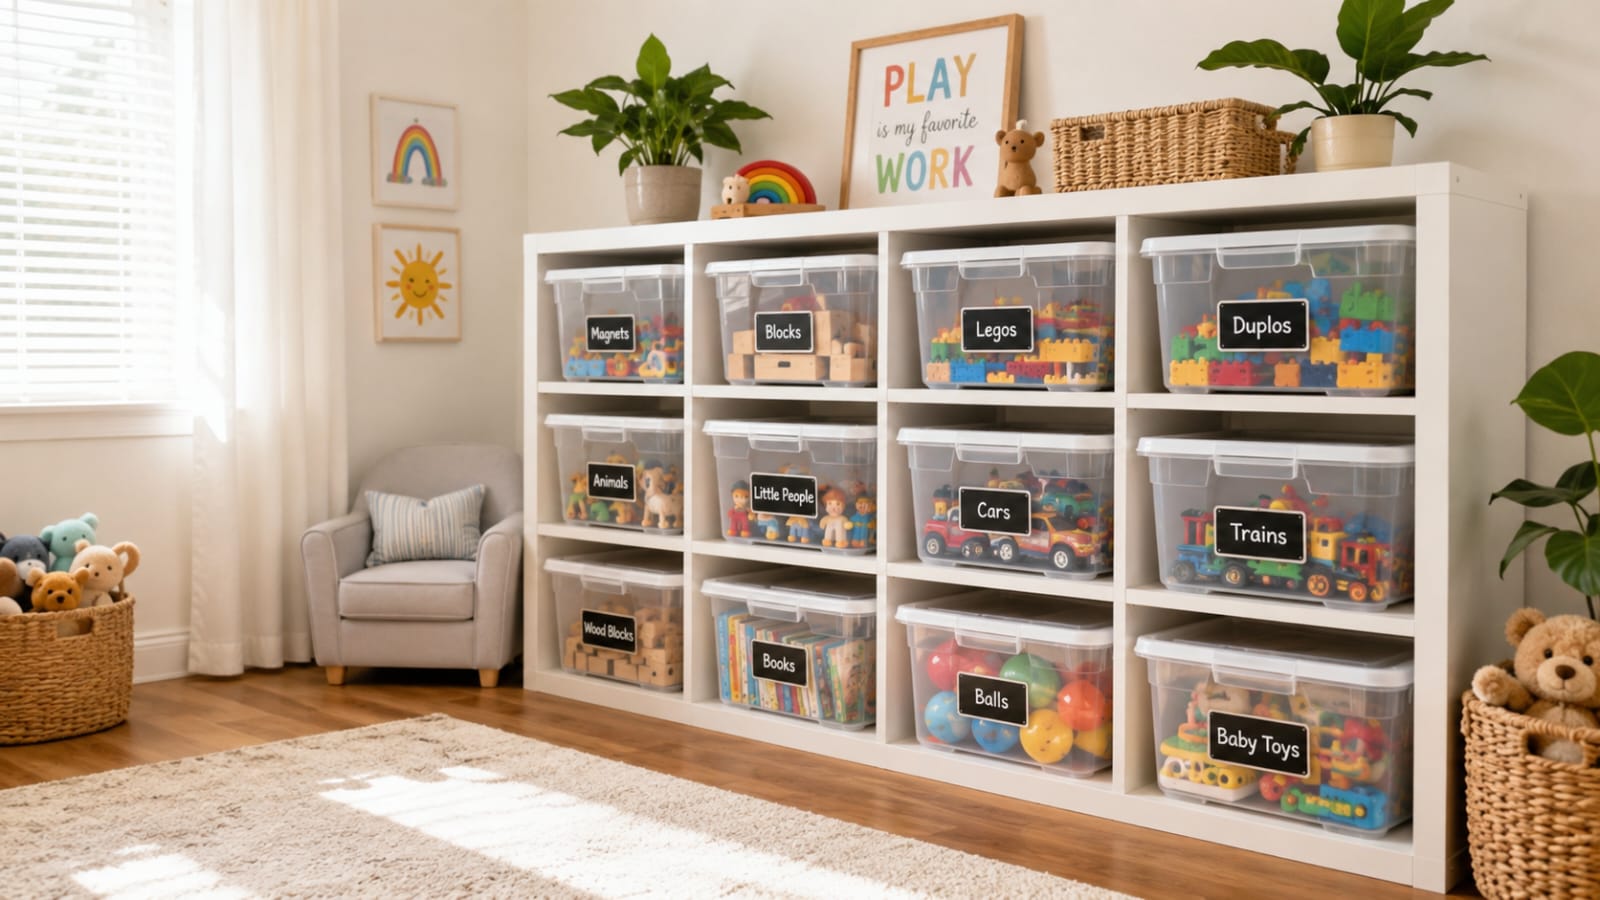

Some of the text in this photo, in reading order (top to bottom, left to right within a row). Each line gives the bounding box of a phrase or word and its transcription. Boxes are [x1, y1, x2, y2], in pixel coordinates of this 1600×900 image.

[884, 53, 977, 108] PLAY
[876, 107, 979, 147] is my favorite
[876, 145, 975, 194] WORK
[591, 326, 630, 344] Magnets
[764, 323, 802, 340] Blocks
[976, 320, 1017, 343] Legos
[1232, 314, 1292, 340] Duplos
[593, 473, 629, 490] Animals
[753, 485, 815, 507] Little People
[977, 501, 1011, 520] Cars
[1229, 522, 1287, 545] Trains
[584, 622, 634, 642] Wood Blocks
[762, 652, 796, 673] Books
[974, 687, 1009, 710] Balls
[1217, 727, 1300, 762] Baby Toys
